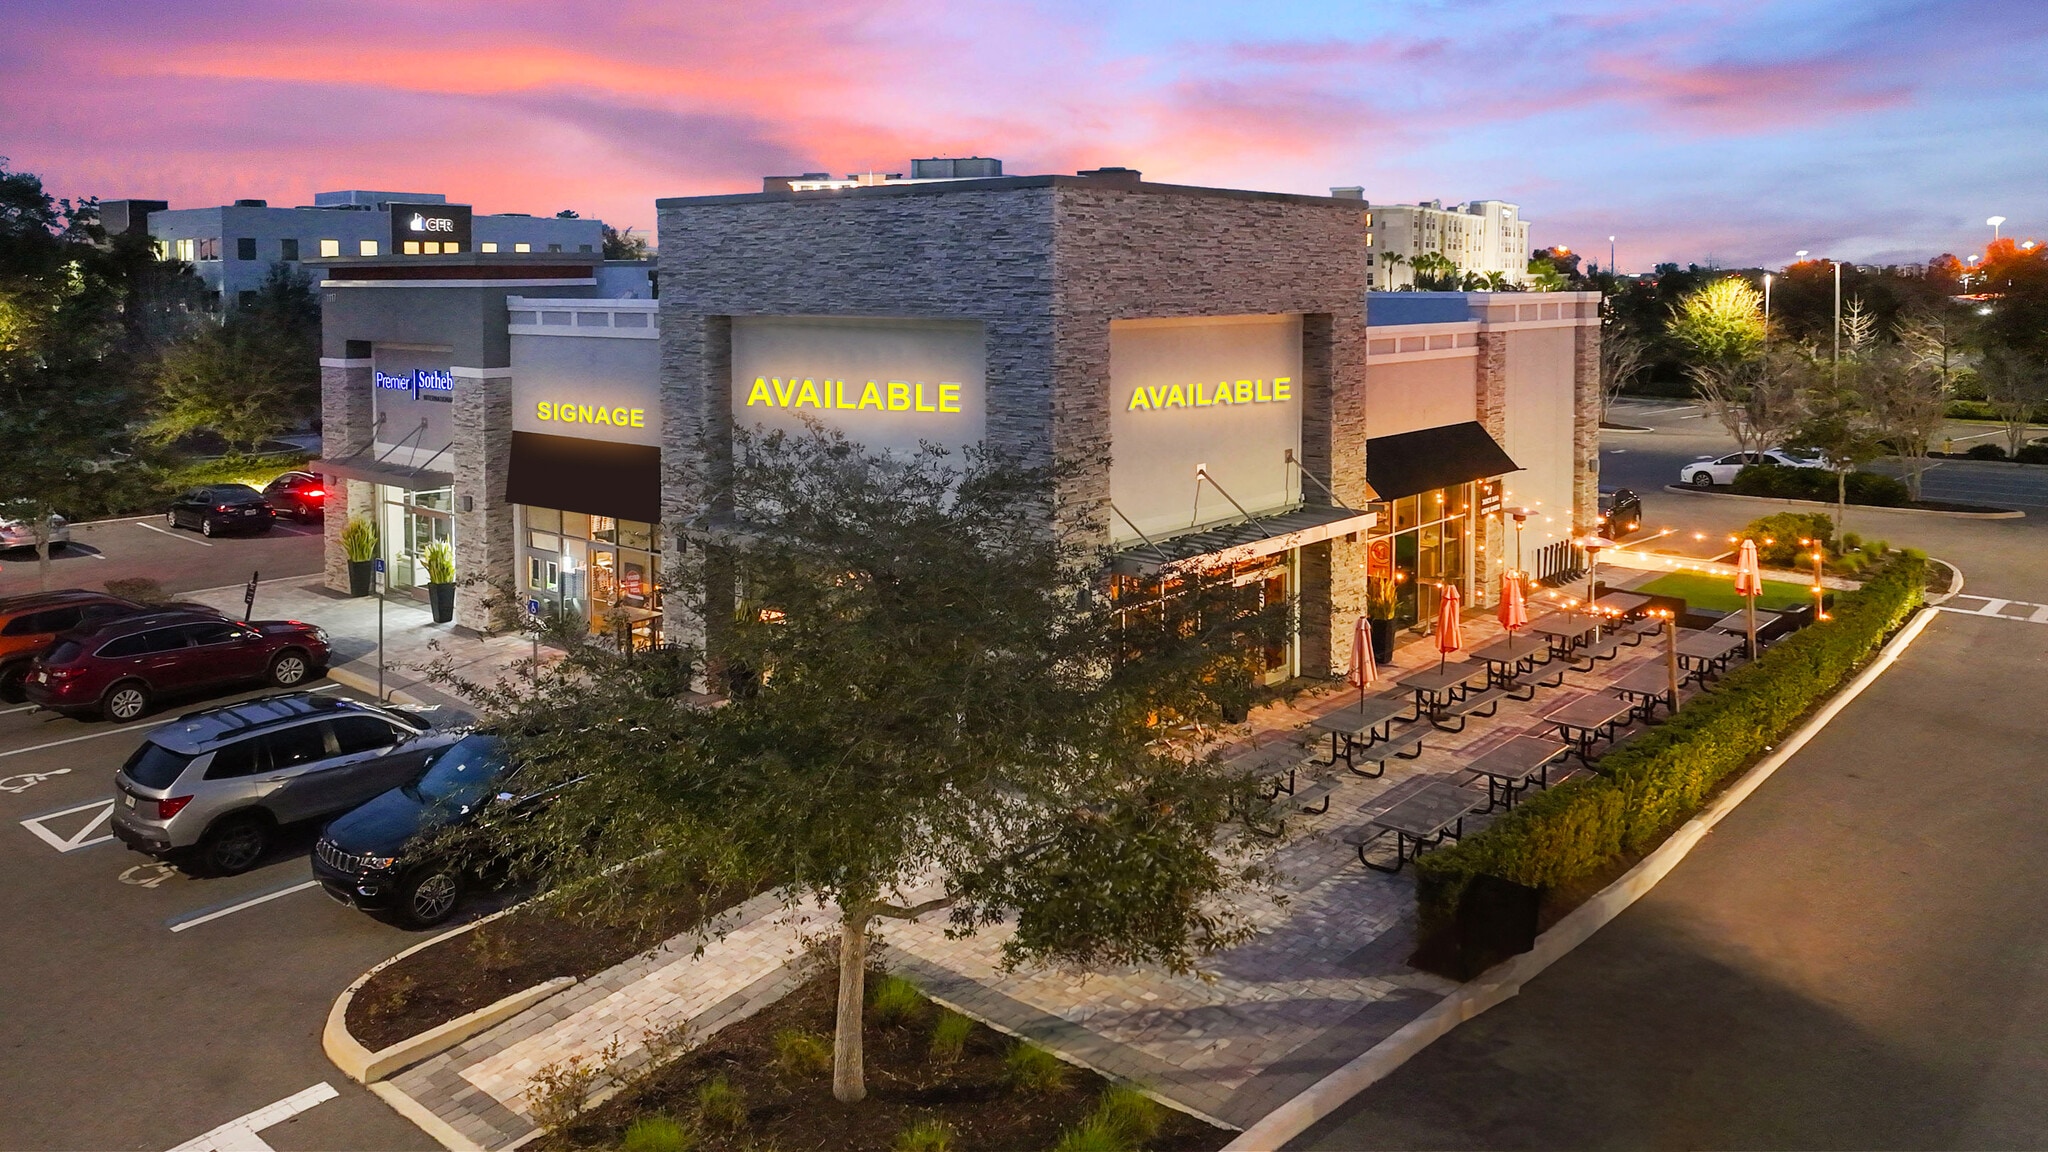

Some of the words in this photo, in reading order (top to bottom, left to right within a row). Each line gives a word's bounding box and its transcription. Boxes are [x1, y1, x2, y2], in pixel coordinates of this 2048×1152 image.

[426, 218, 453, 232] CFR
[376, 372, 411, 390] Premier
[746, 376, 962, 413] AVAILABLE
[1127, 376, 1292, 411] AVAILABLE
[537, 401, 645, 428] SIGNAGE
